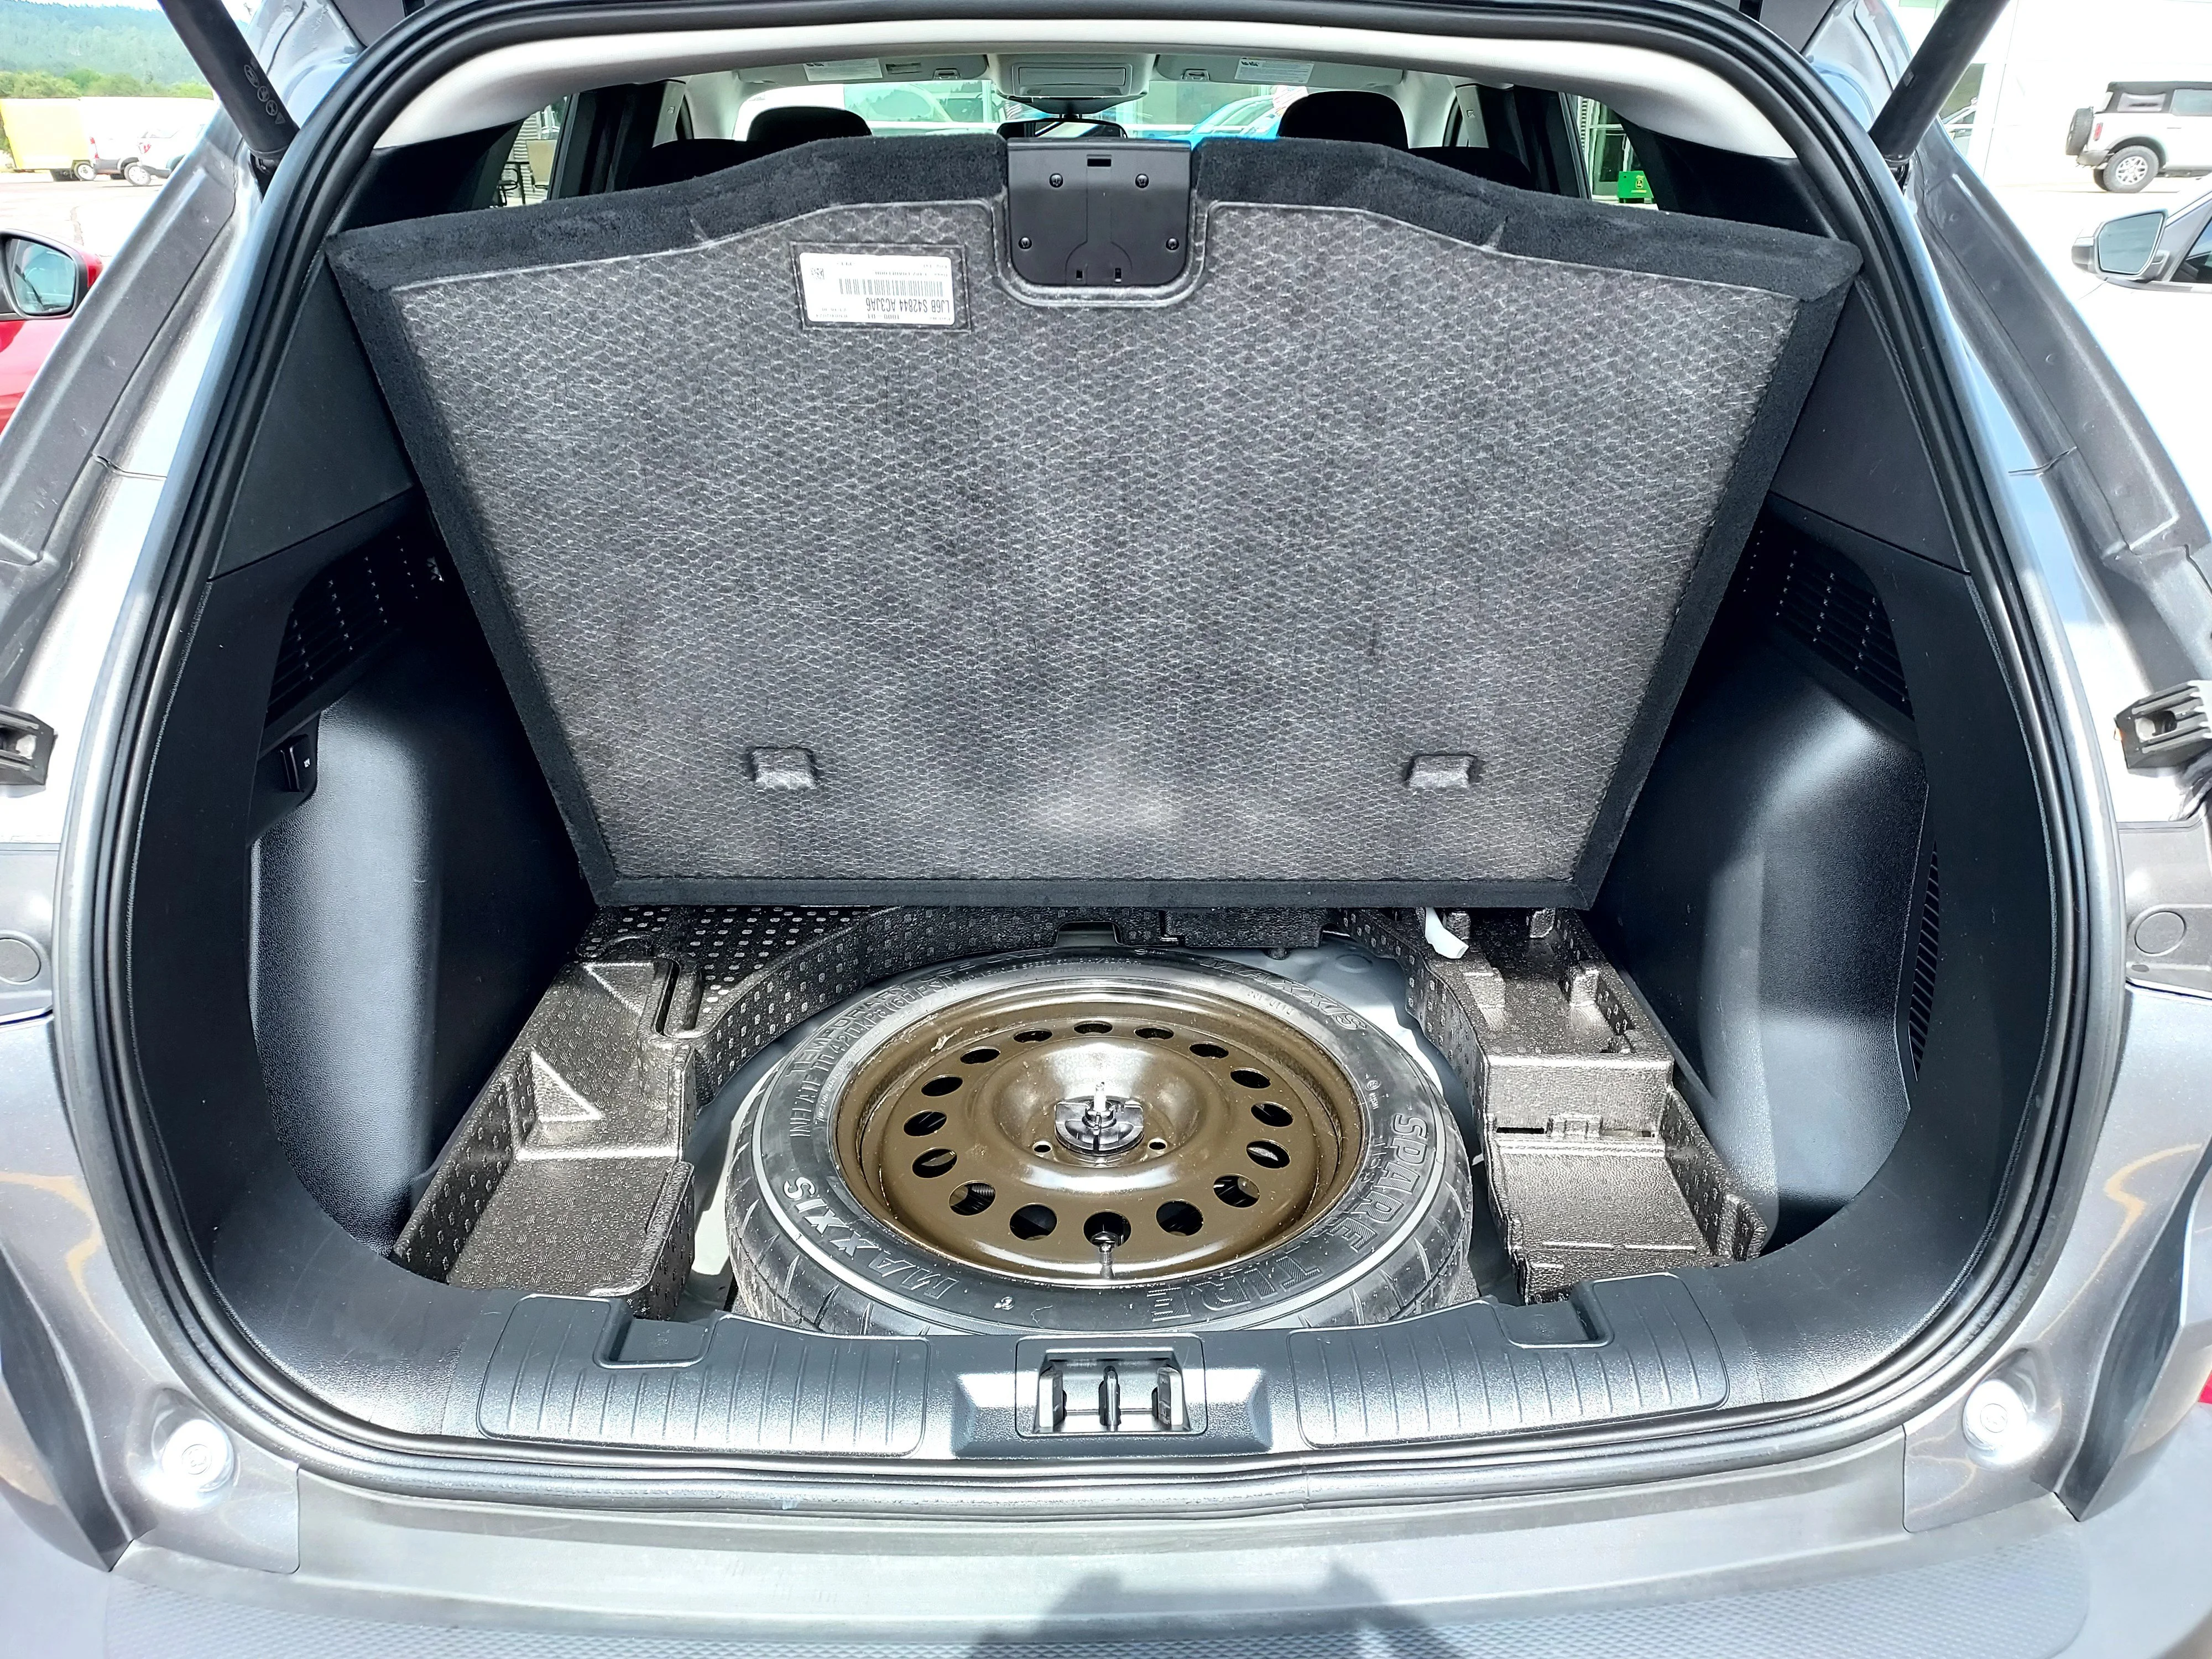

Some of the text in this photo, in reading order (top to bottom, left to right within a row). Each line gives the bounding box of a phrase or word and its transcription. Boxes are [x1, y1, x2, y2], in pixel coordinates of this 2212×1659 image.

[866, 298, 950, 313] LJ6B S42844 AC3JA6
[786, 983, 908, 1077] TEMPORARY
[1199, 958, 1367, 1030] MAXXIS
[790, 1073, 821, 1137] INFLATE
[783, 1177, 959, 1300] MAXXIS
[1146, 1113, 1428, 1322] SPARE TIRE
